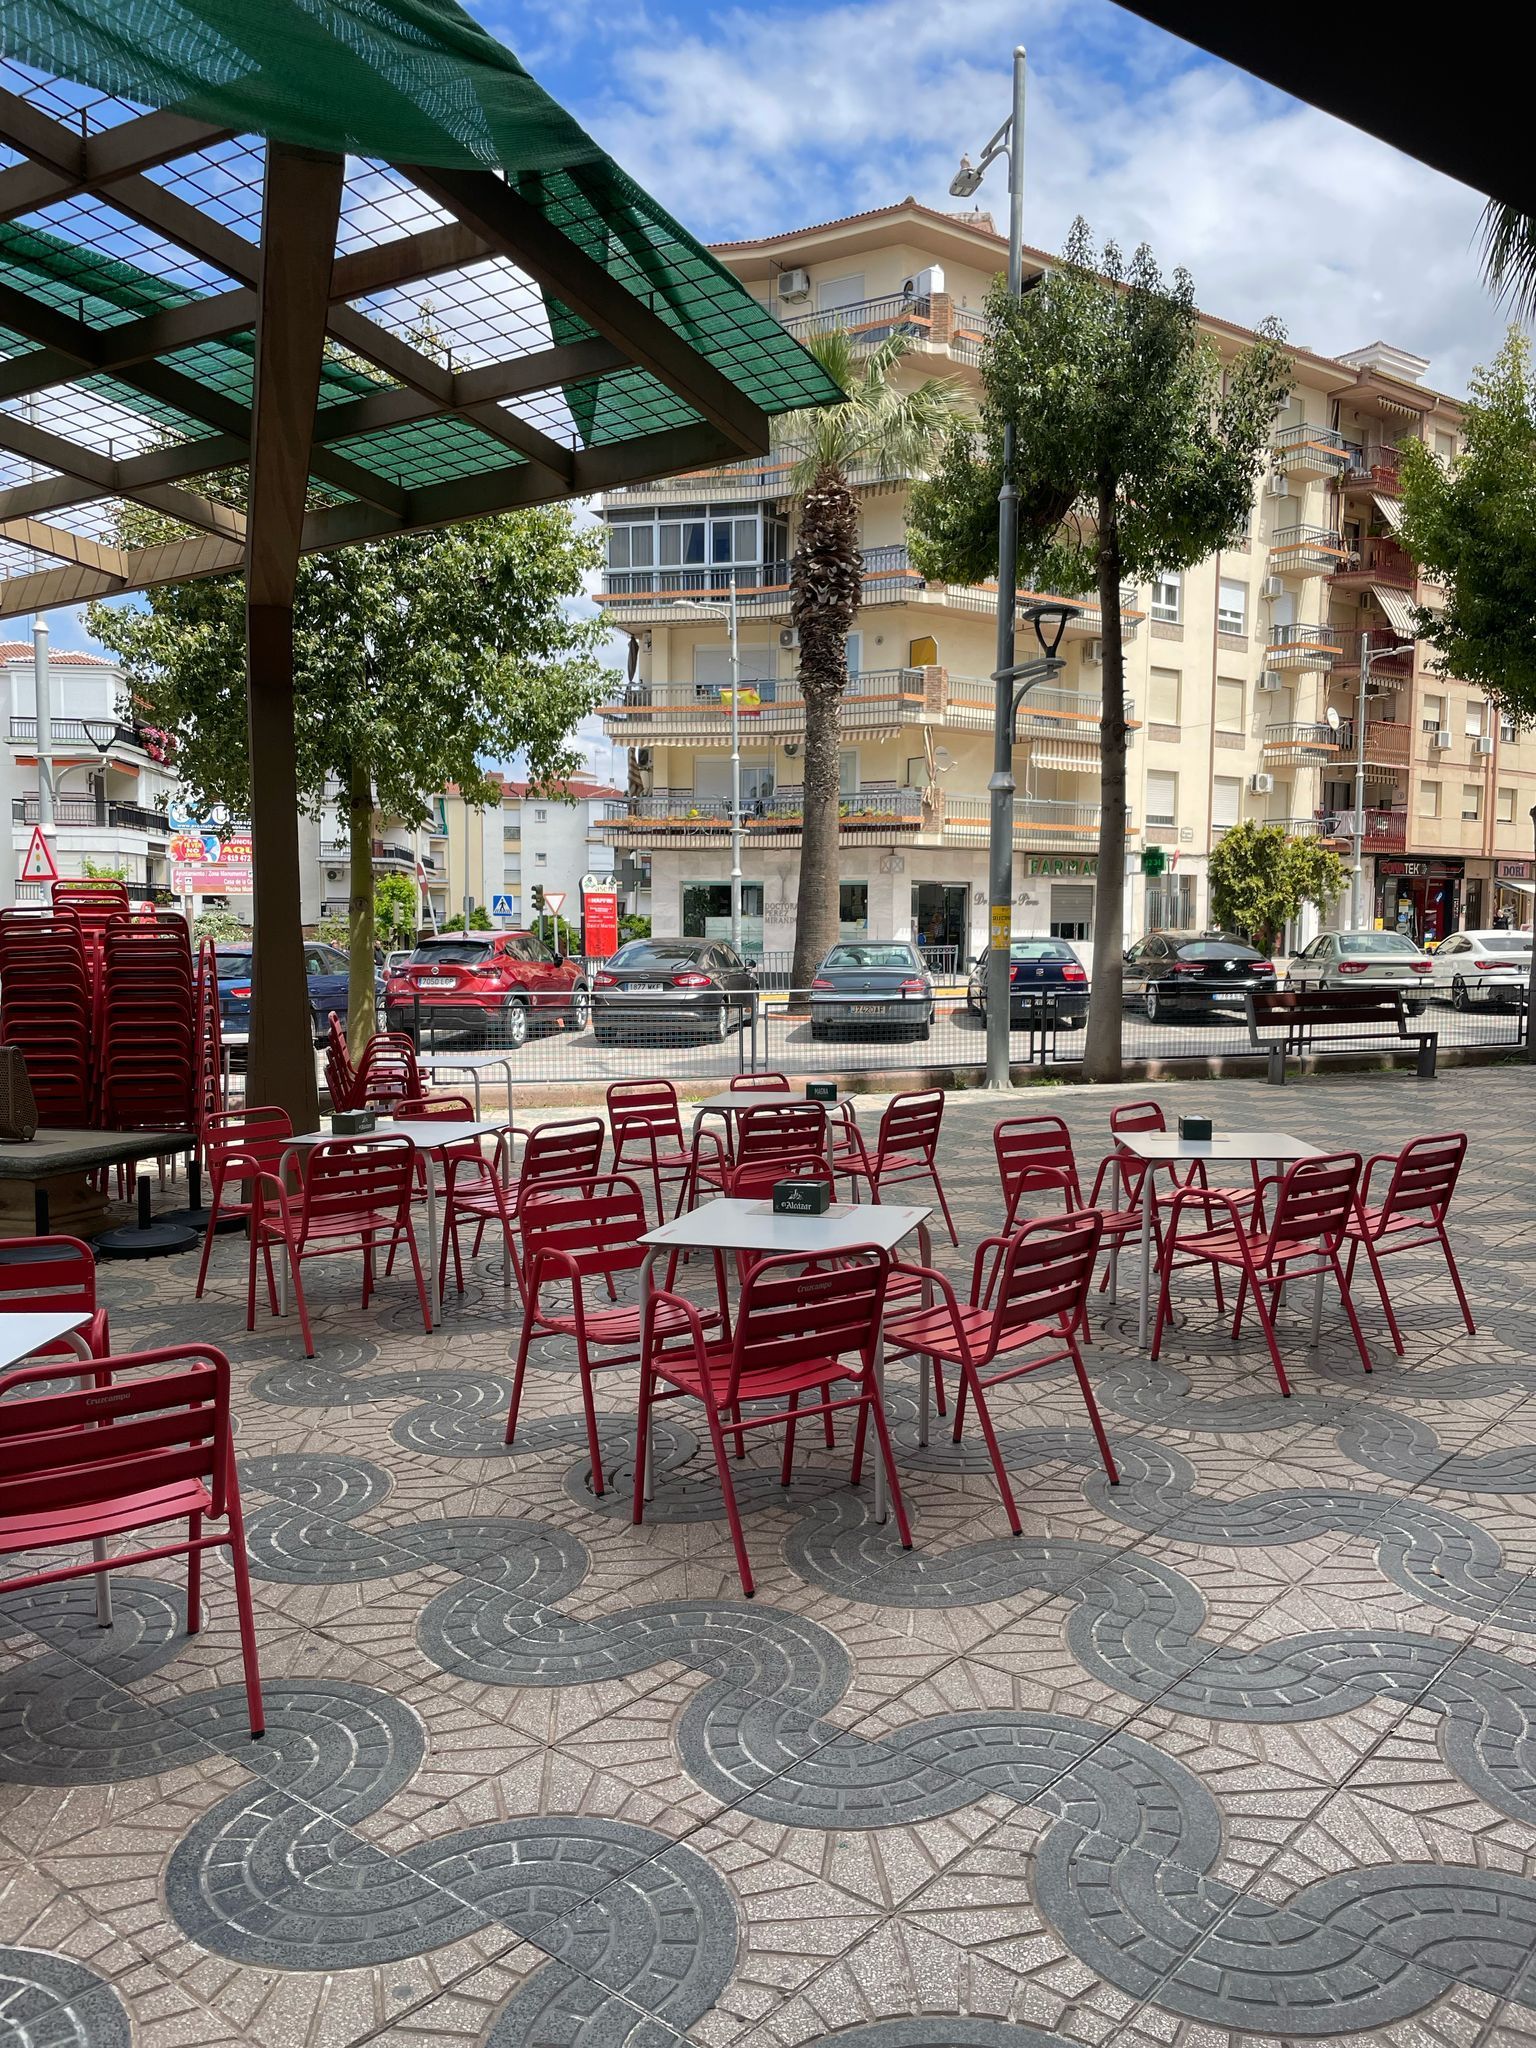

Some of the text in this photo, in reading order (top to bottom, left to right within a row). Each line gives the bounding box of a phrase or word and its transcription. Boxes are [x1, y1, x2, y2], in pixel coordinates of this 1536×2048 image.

[1503, 865, 1525, 877] DORI
[797, 1281, 833, 1294] Cruzcampo
[86, 1392, 131, 1406] Cruzcampo
